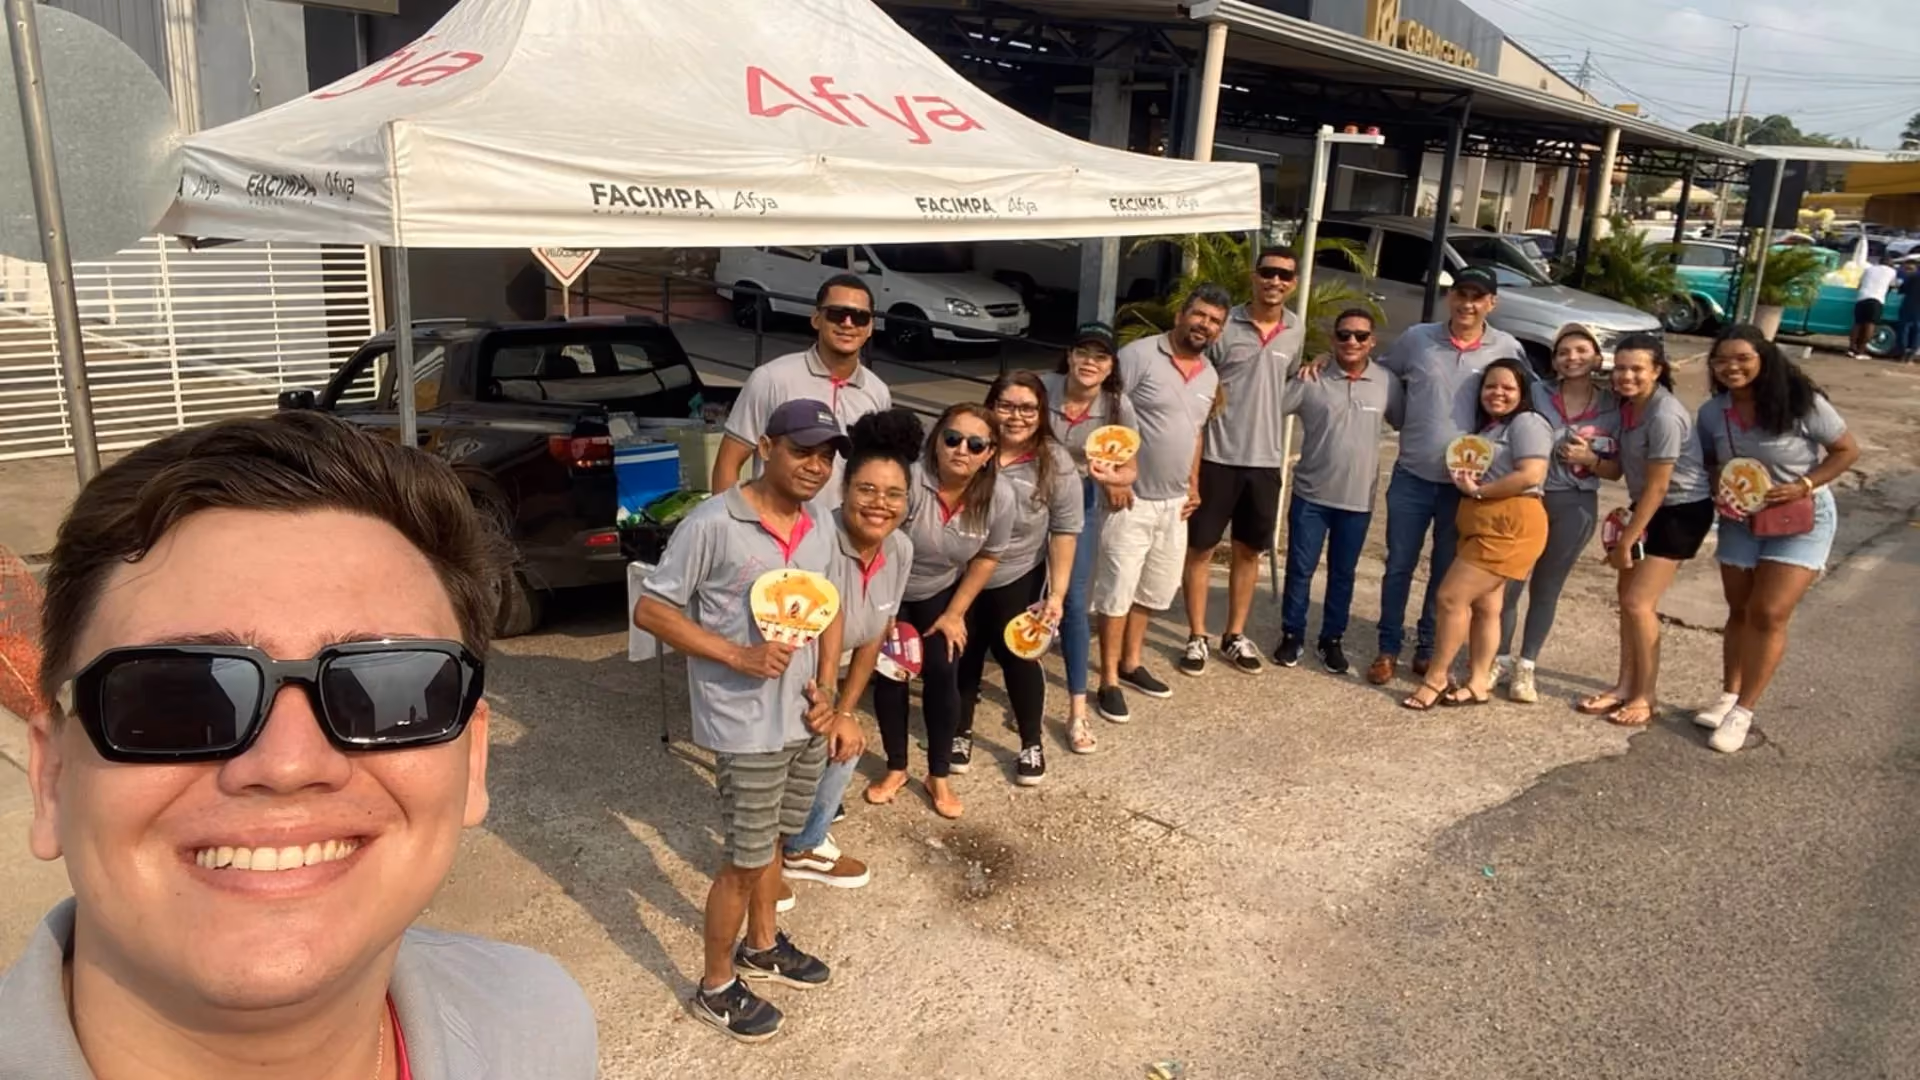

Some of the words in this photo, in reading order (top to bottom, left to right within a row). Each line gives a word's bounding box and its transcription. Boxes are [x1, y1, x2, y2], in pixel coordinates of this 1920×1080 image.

[312, 35, 484, 99] ya
[746, 65, 987, 145] Afya
[246, 173, 317, 197] FACIMPA
[589, 182, 715, 210] FACIMPA
[733, 190, 779, 216] Afya
[914, 196, 998, 214] FACIMPA
